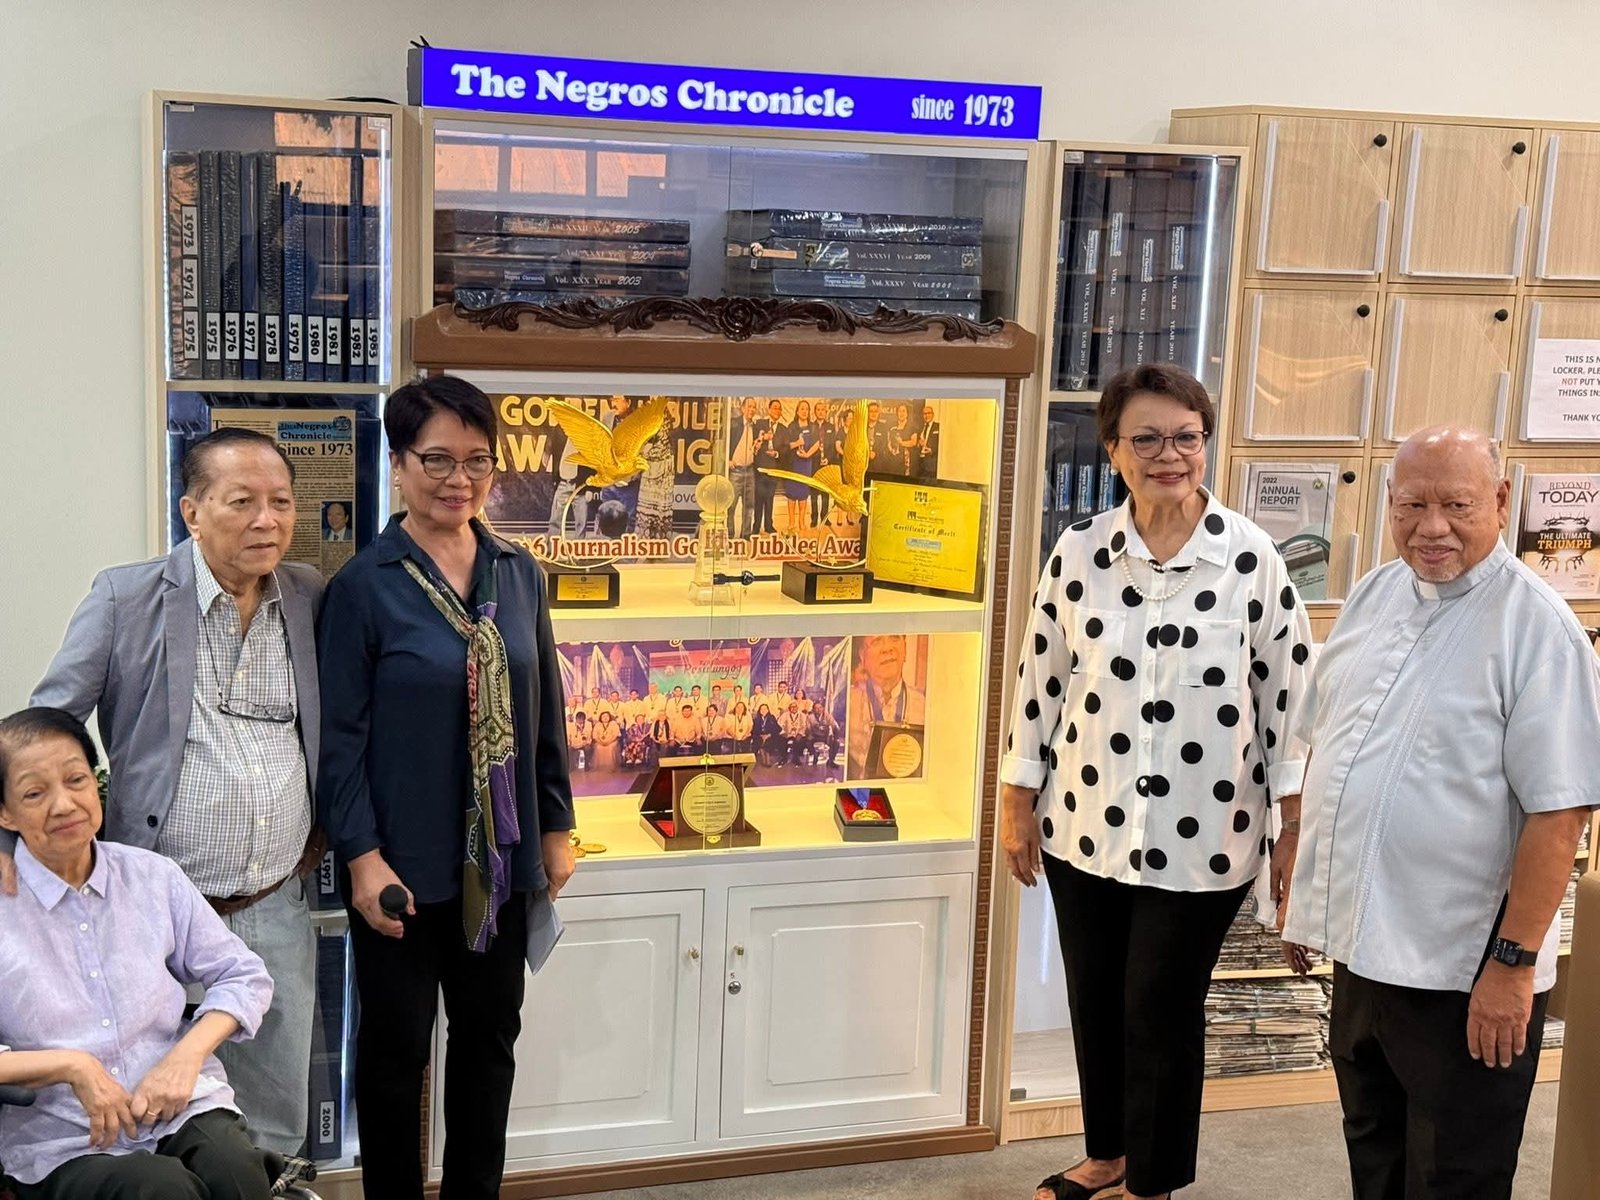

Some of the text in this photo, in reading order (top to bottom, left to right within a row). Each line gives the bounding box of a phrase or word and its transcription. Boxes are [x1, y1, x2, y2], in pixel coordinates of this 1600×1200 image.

[450, 63, 1015, 127] The Negros Chronicle since 1973
[183, 213, 195, 248] 1973
[614, 225, 641, 234] 2005
[183, 266, 195, 300] 1974
[617, 275, 642, 286] 2003
[184, 319, 196, 353] 1975
[207, 320, 219, 353] 1975
[227, 319, 239, 353] 1976
[244, 319, 256, 352] 1977
[267, 322, 277, 355] 1978
[288, 321, 299, 354] 1979
[309, 323, 321, 356] 1980
[327, 325, 340, 356] 1981
[350, 326, 362, 359] 1982
[368, 326, 379, 358] 1983
[1553, 366, 1586, 374] LOCKER.
[1565, 355, 1584, 363] THIS
[1558, 389, 1588, 397] THINGS
[1561, 378, 1578, 386] NOT
[1580, 378, 1595, 386] PUT
[1563, 414, 1589, 422] THANK
[280, 431, 332, 440] Chronicle
[277, 442, 353, 456] Since 1973
[1260, 486, 1301, 495] ANNUAL
[1538, 490, 1600, 504] TODAY
[1549, 482, 1591, 490] BEYOND
[1260, 496, 1301, 505] REPORT
[551, 535, 669, 561] Journalism
[750, 535, 818, 558] Jubilee
[1537, 539, 1592, 549] TRIUMPH
[1540, 532, 1554, 540] THE
[321, 857, 332, 887] 1997
[322, 1107, 332, 1137] 2000
